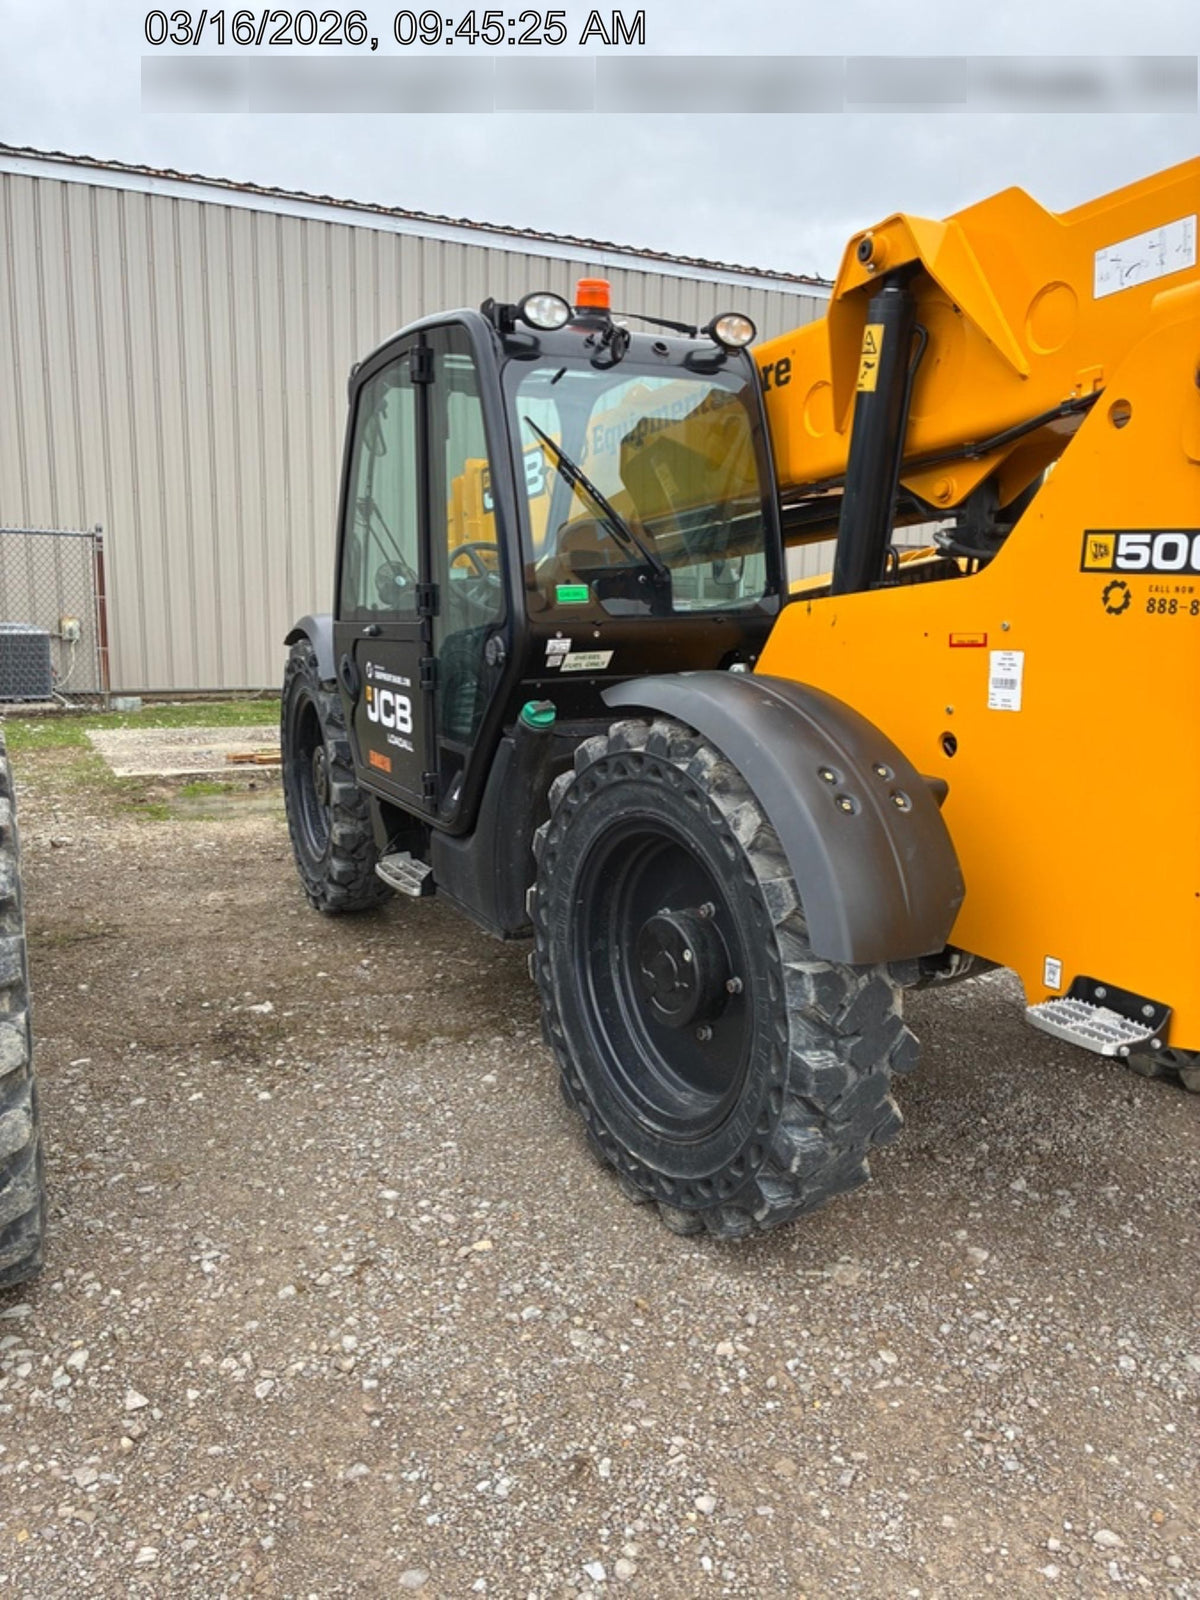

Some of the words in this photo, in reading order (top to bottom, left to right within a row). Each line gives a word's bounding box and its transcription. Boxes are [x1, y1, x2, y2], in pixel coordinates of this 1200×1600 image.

[1115, 533, 1200, 570] 50
[1148, 584, 1170, 593] CALL
[1175, 586, 1195, 594] NOW
[366, 687, 413, 734] JCB
